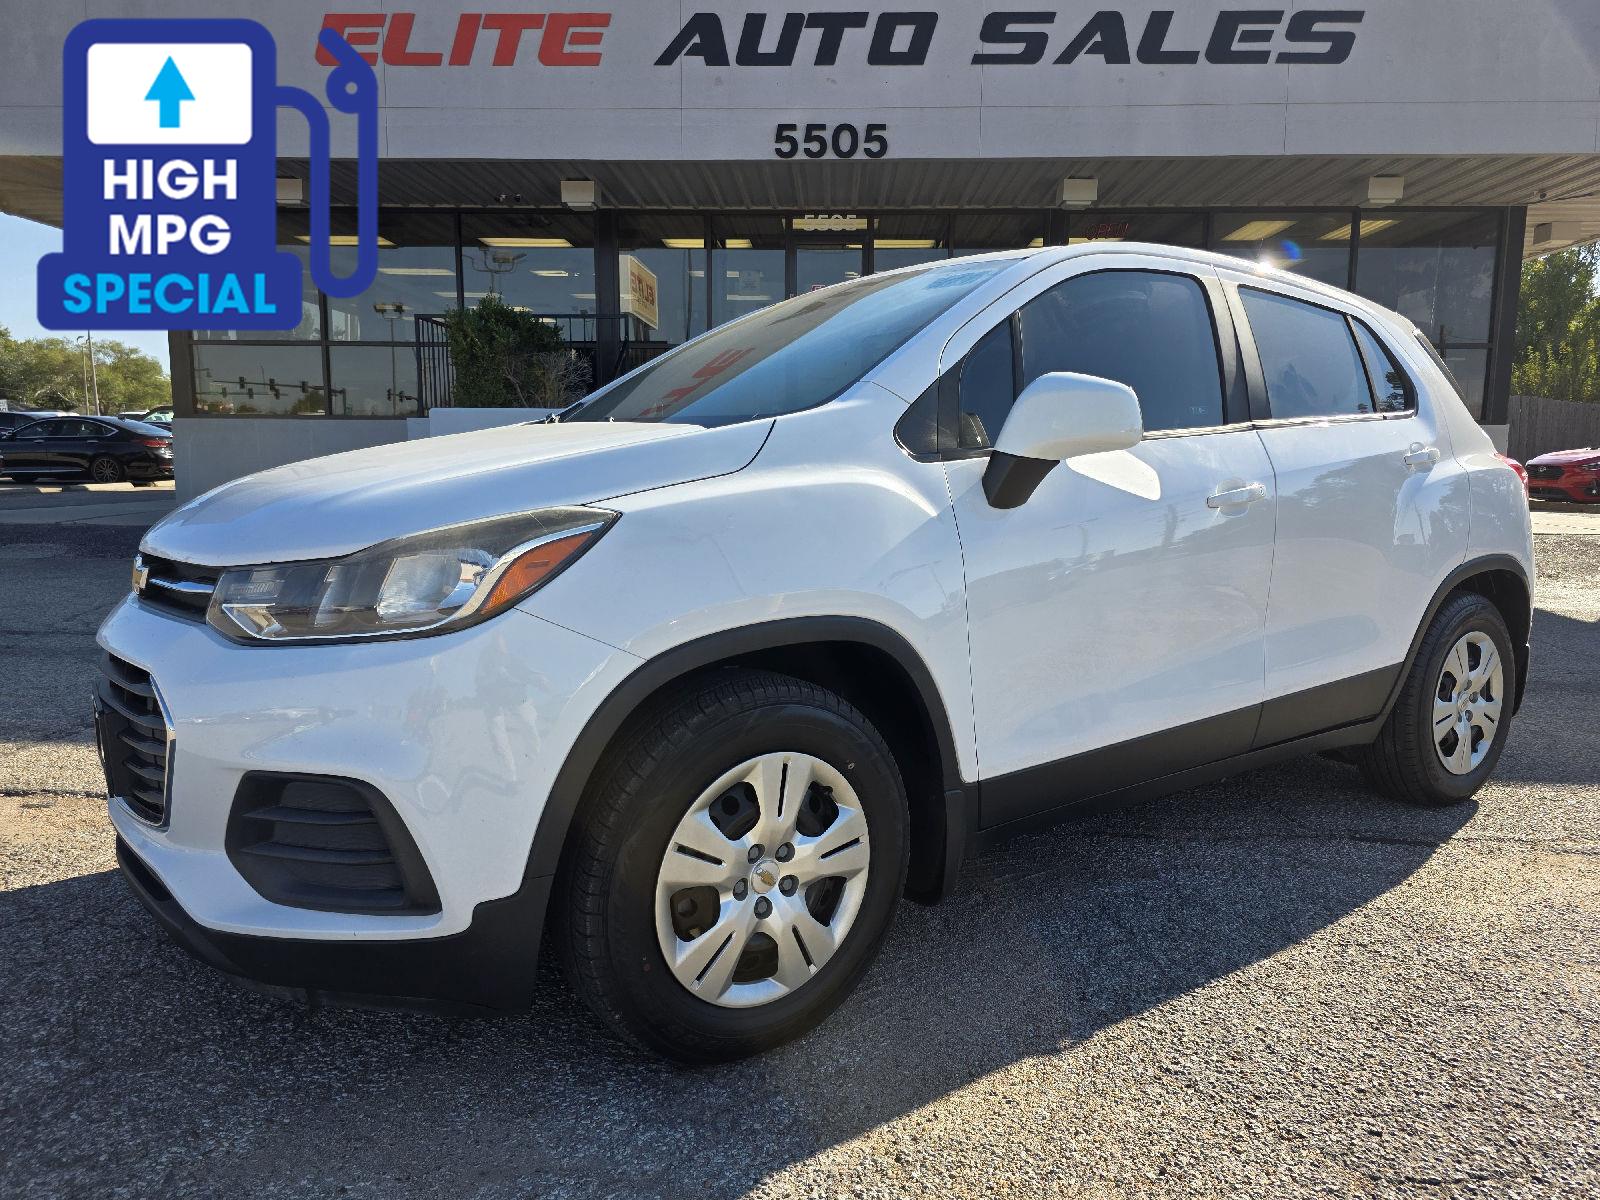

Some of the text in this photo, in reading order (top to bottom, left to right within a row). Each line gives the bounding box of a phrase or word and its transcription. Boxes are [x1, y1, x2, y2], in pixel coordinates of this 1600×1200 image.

[315, 10, 1365, 66] ELITE AUTO SALES
[774, 123, 888, 158] 5505
